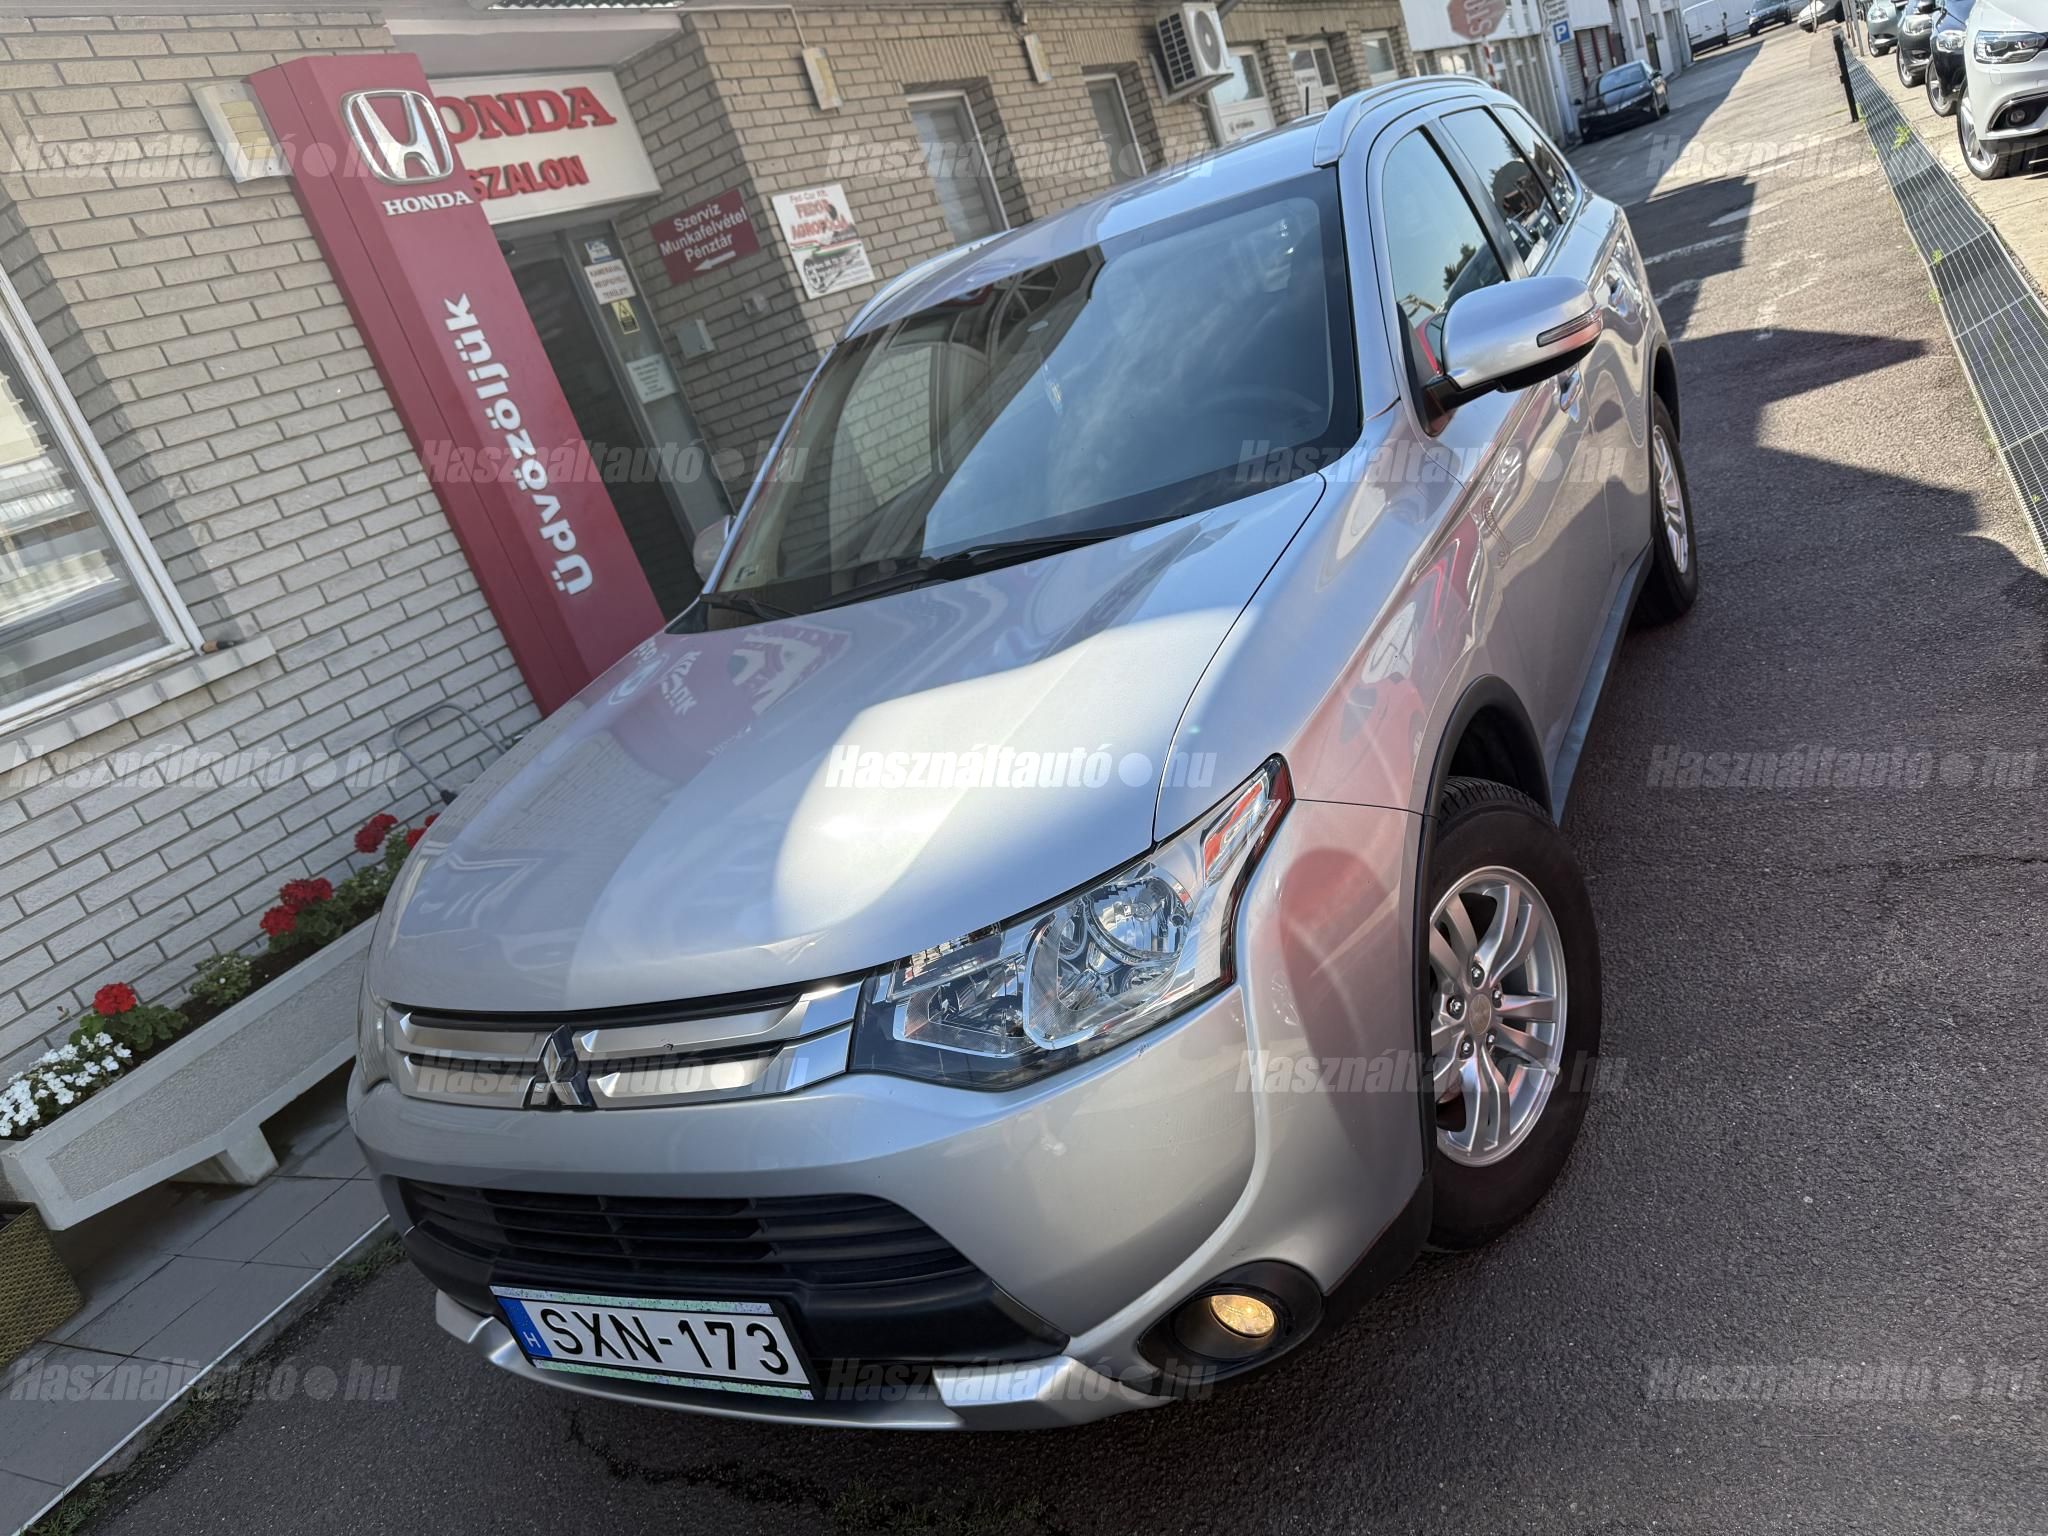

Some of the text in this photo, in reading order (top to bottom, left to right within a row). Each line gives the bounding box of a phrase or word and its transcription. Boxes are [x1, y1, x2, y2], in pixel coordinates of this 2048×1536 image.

[433, 87, 617, 144] ONDA
[381, 190, 474, 216] HONDA
[673, 203, 722, 232] Szerviz
[659, 206, 748, 256] Munkafelvétel
[684, 233, 733, 263] Pénztár
[444, 292, 593, 595] Üdvözöljük
[539, 1307, 789, 1376] SXN-173
